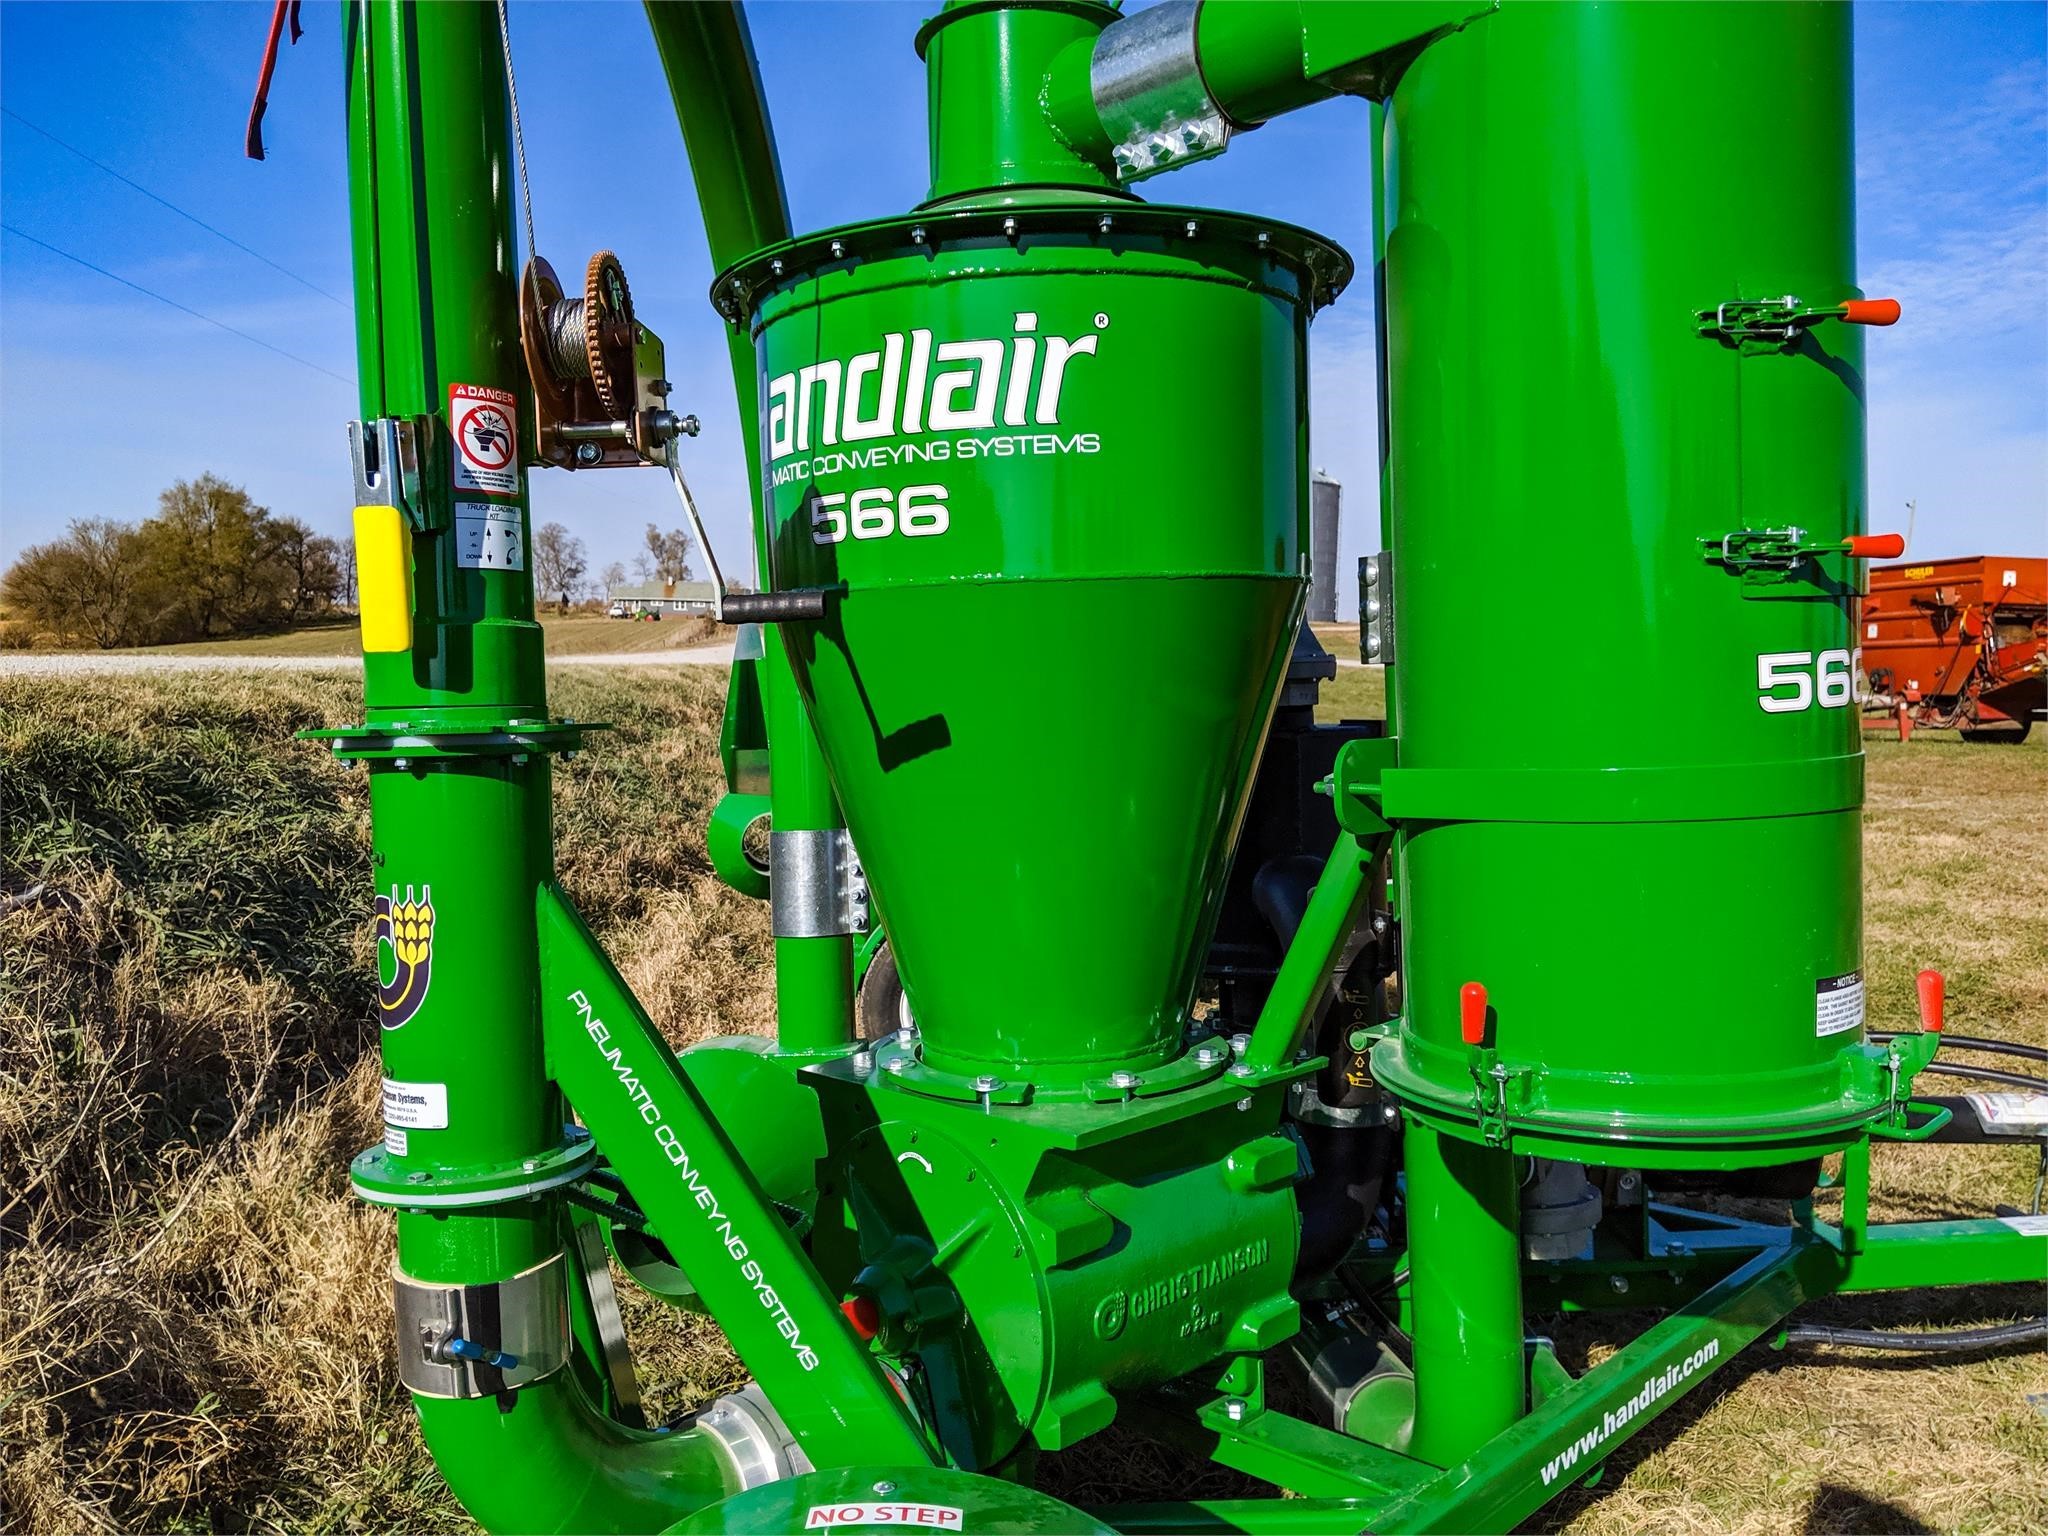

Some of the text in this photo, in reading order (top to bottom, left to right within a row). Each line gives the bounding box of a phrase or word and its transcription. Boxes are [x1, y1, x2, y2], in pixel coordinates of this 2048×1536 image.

[467, 385, 514, 404] DANGER
[812, 440, 950, 476] CONVEYING
[956, 434, 1101, 458] SYSTEMS
[492, 506, 516, 514] LOADING
[810, 484, 950, 545] 566
[398, 1092, 428, 1107] Systems,
[567, 990, 661, 1126] PNEUMATIC
[741, 1261, 819, 1372] SYSTEMS
[1131, 1237, 1270, 1320] CHRISTIANSON
[1540, 1338, 1720, 1487] www.handlair.com
[810, 1506, 958, 1525] NO STEP
